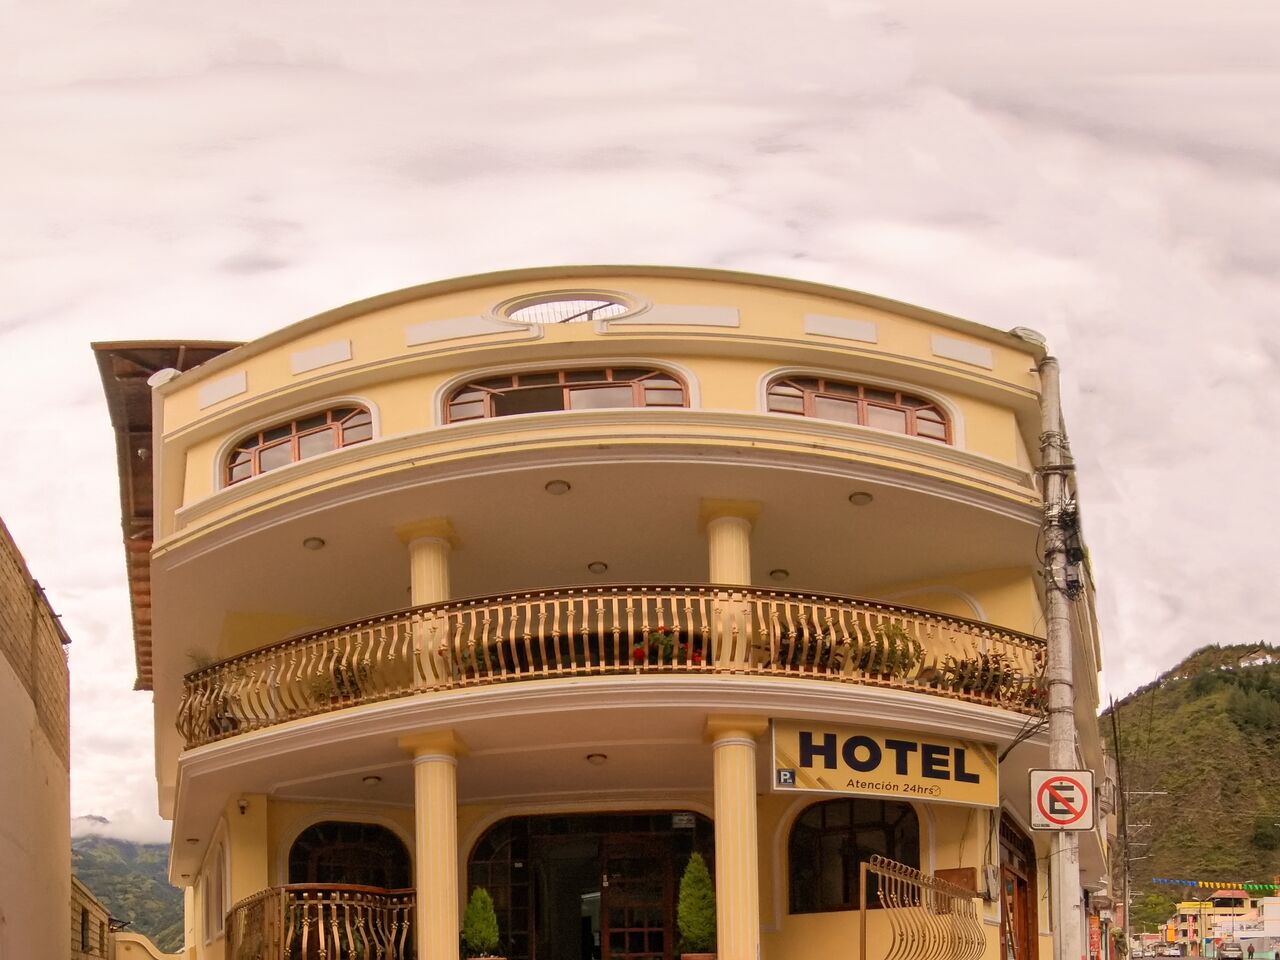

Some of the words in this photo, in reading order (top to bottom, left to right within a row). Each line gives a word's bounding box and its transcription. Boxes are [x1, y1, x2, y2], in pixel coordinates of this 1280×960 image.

[799, 731, 980, 785] HOTEL
[846, 778, 899, 792] Atención
[902, 783, 934, 795] 24hrs
[1049, 785, 1074, 814] E
